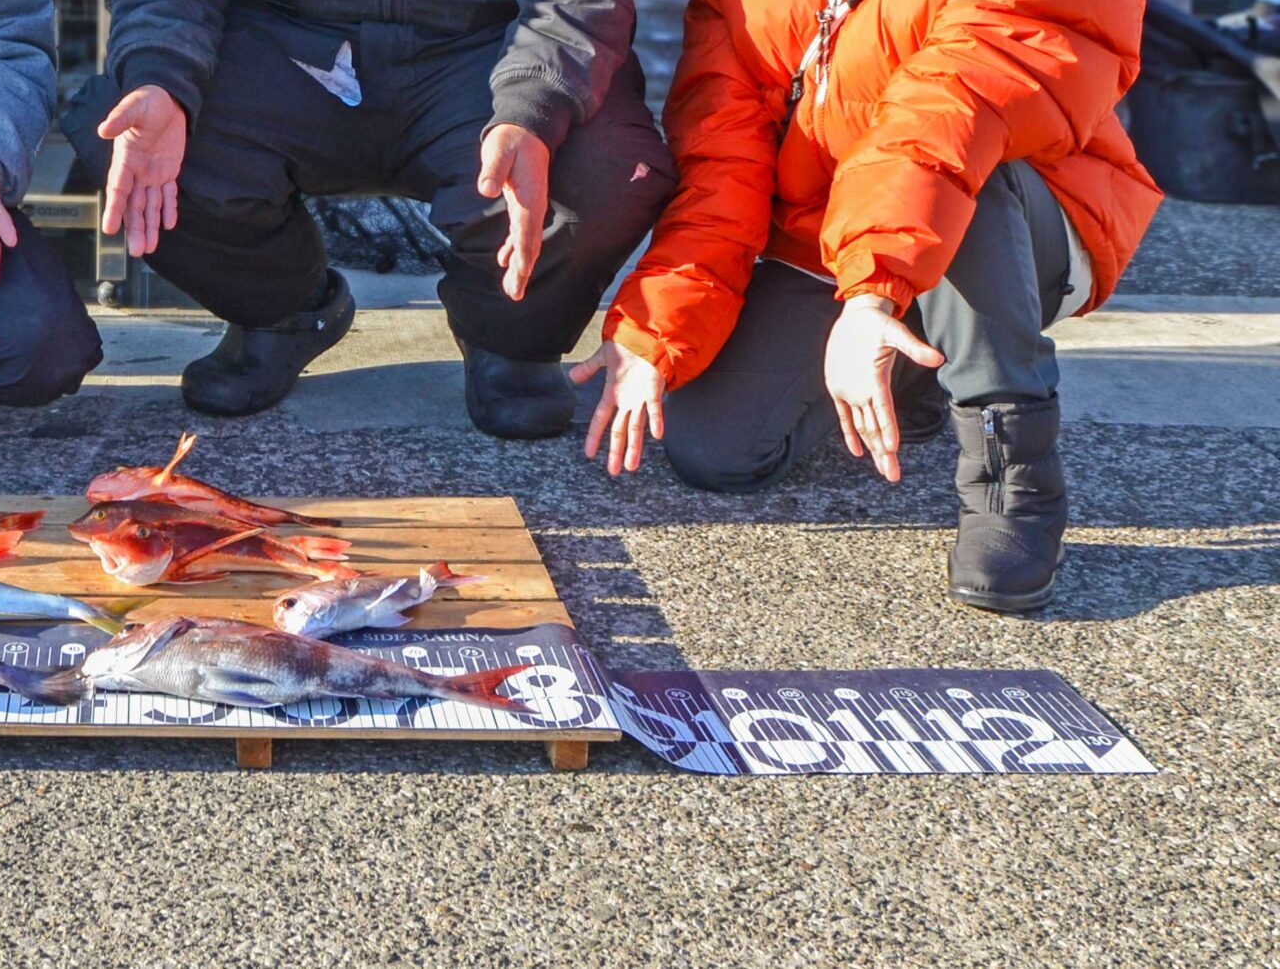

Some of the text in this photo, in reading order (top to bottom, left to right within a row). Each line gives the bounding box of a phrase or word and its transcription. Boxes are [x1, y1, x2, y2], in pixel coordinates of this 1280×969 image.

[362, 633, 407, 642] SIDE
[412, 632, 495, 643] MARINA
[1080, 735, 1113, 746] 130
